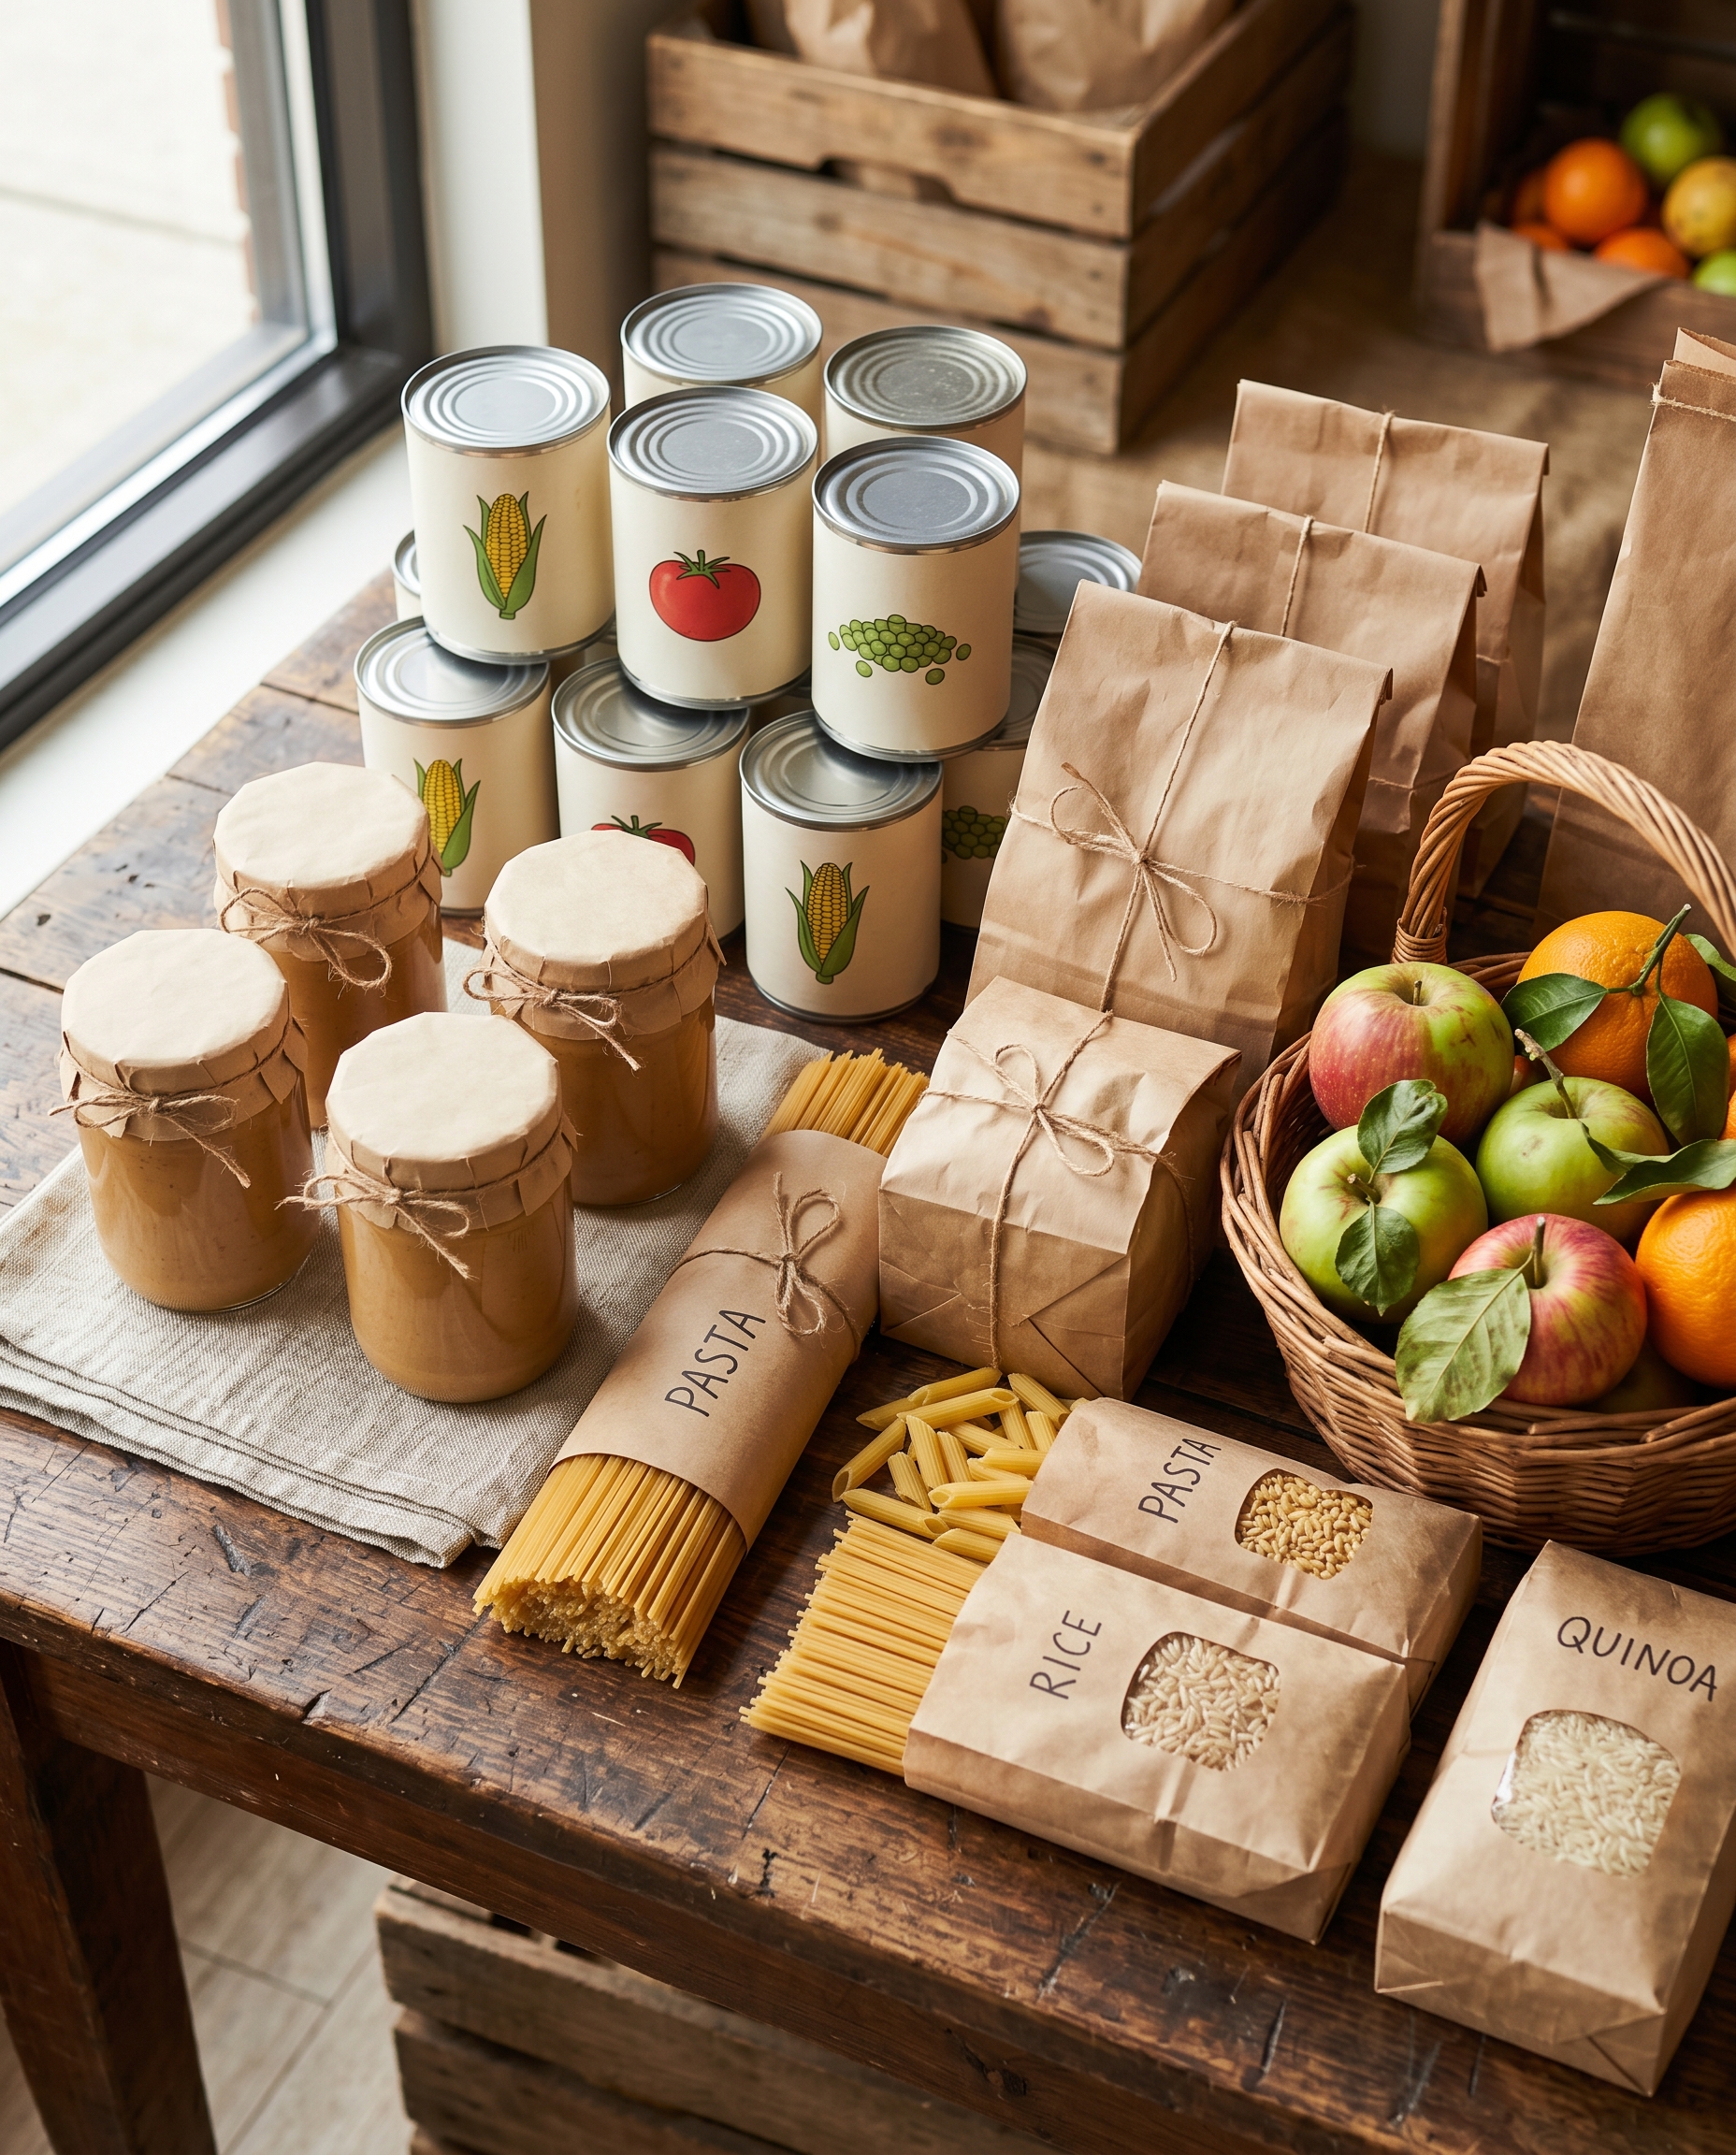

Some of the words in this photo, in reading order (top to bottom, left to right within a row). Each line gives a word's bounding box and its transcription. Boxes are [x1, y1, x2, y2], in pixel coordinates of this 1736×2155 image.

[664, 1310, 766, 1417] PASTA
[1138, 1439, 1222, 1524] PASTA
[1029, 1611, 1102, 1699] RICE
[1557, 1616, 1717, 1701] QUINOA
